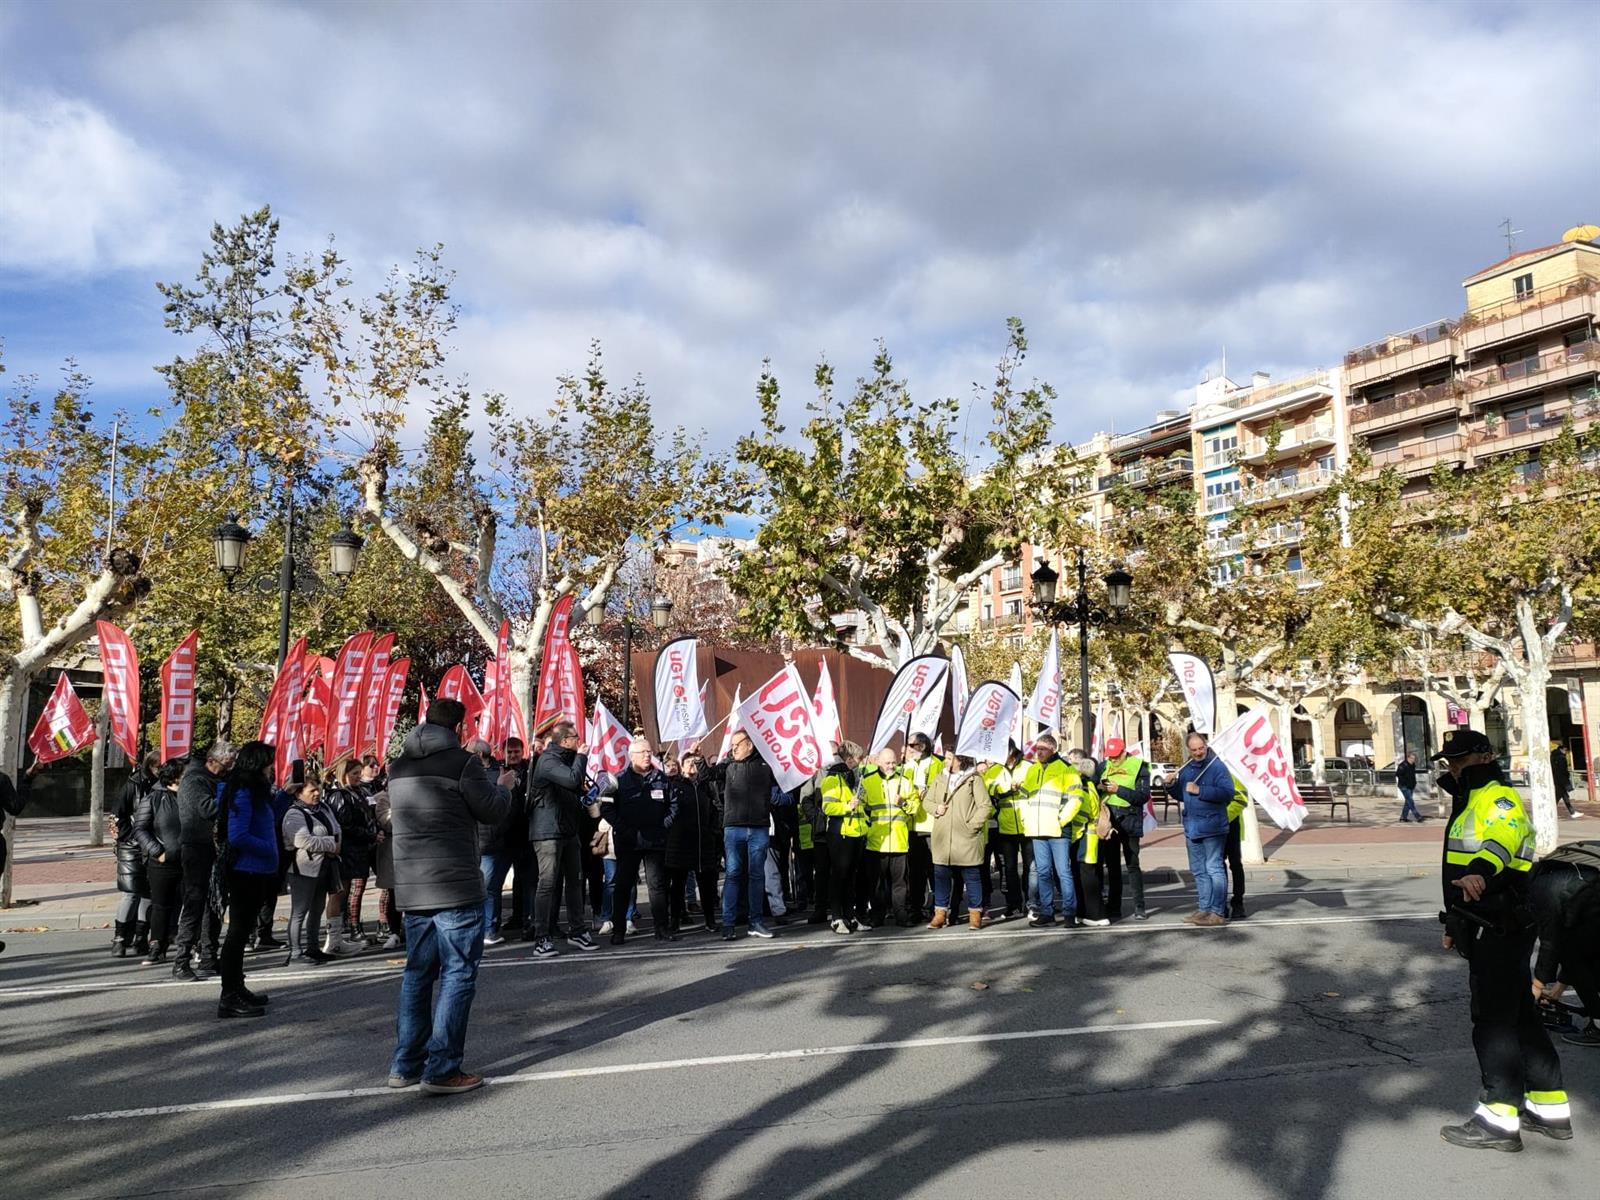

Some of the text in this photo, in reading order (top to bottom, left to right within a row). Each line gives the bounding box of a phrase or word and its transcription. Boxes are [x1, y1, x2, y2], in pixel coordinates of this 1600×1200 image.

[668, 650, 684, 683] UGT
[911, 663, 930, 698] UGT
[165, 647, 193, 747] CCOO
[758, 671, 823, 776] USO
[986, 689, 1004, 718] UGT
[750, 710, 792, 772] LA RIOJA
[1240, 754, 1294, 811] LA RIOJA
